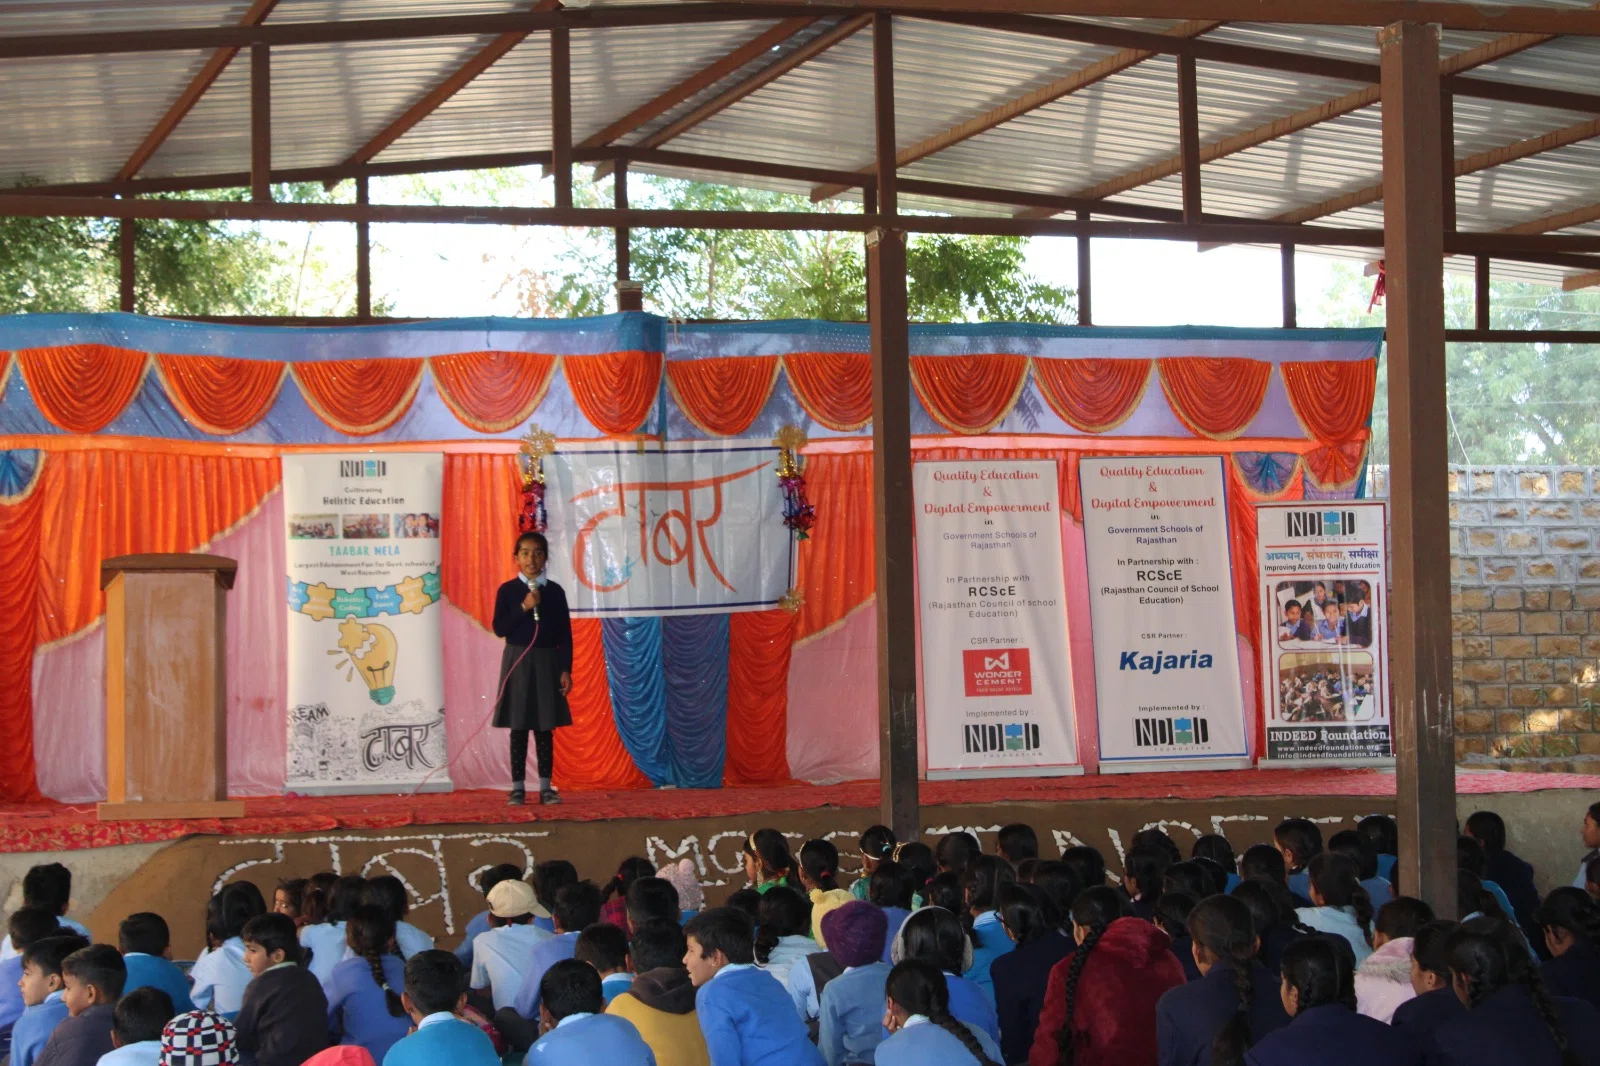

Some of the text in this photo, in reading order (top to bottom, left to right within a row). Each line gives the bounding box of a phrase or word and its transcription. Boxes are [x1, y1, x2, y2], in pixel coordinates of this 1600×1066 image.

[934, 470, 1040, 484] Quality Education
[1100, 466, 1204, 479] Quality Education
[983, 486, 992, 496] &
[1148, 481, 1158, 492] &
[323, 497, 405, 505] Holistic Education
[1091, 497, 1216, 511] Digital Empowerment
[924, 502, 1051, 516] Digital Empowerment
[568, 460, 772, 592] टाबर
[984, 518, 994, 526] in
[1108, 526, 1158, 534] Government
[943, 532, 992, 540] Government
[1136, 537, 1177, 545] Rajasthan
[329, 545, 400, 556] TAABAR MELA
[971, 542, 1011, 550] Rajasthan
[1348, 548, 1378, 559] समीक्षा
[1127, 558, 1175, 566] Partnership
[1177, 557, 1194, 565] with
[958, 576, 1010, 584] Partnership
[1013, 574, 1030, 582] with
[1137, 570, 1182, 581] RCScE
[968, 585, 1016, 596] RCScE
[1101, 587, 1145, 596] (Rajasthan
[1147, 585, 1178, 593] Council
[1139, 596, 1184, 604] Education)
[928, 602, 976, 610] (Rajasthan
[969, 610, 1018, 618] Education)
[1120, 650, 1213, 674] Kajaria
[976, 678, 1022, 686] CEMENT
[966, 710, 1017, 718] Implemented
[1270, 730, 1386, 741] INDEED Foundation
[361, 719, 442, 771] टाबर
